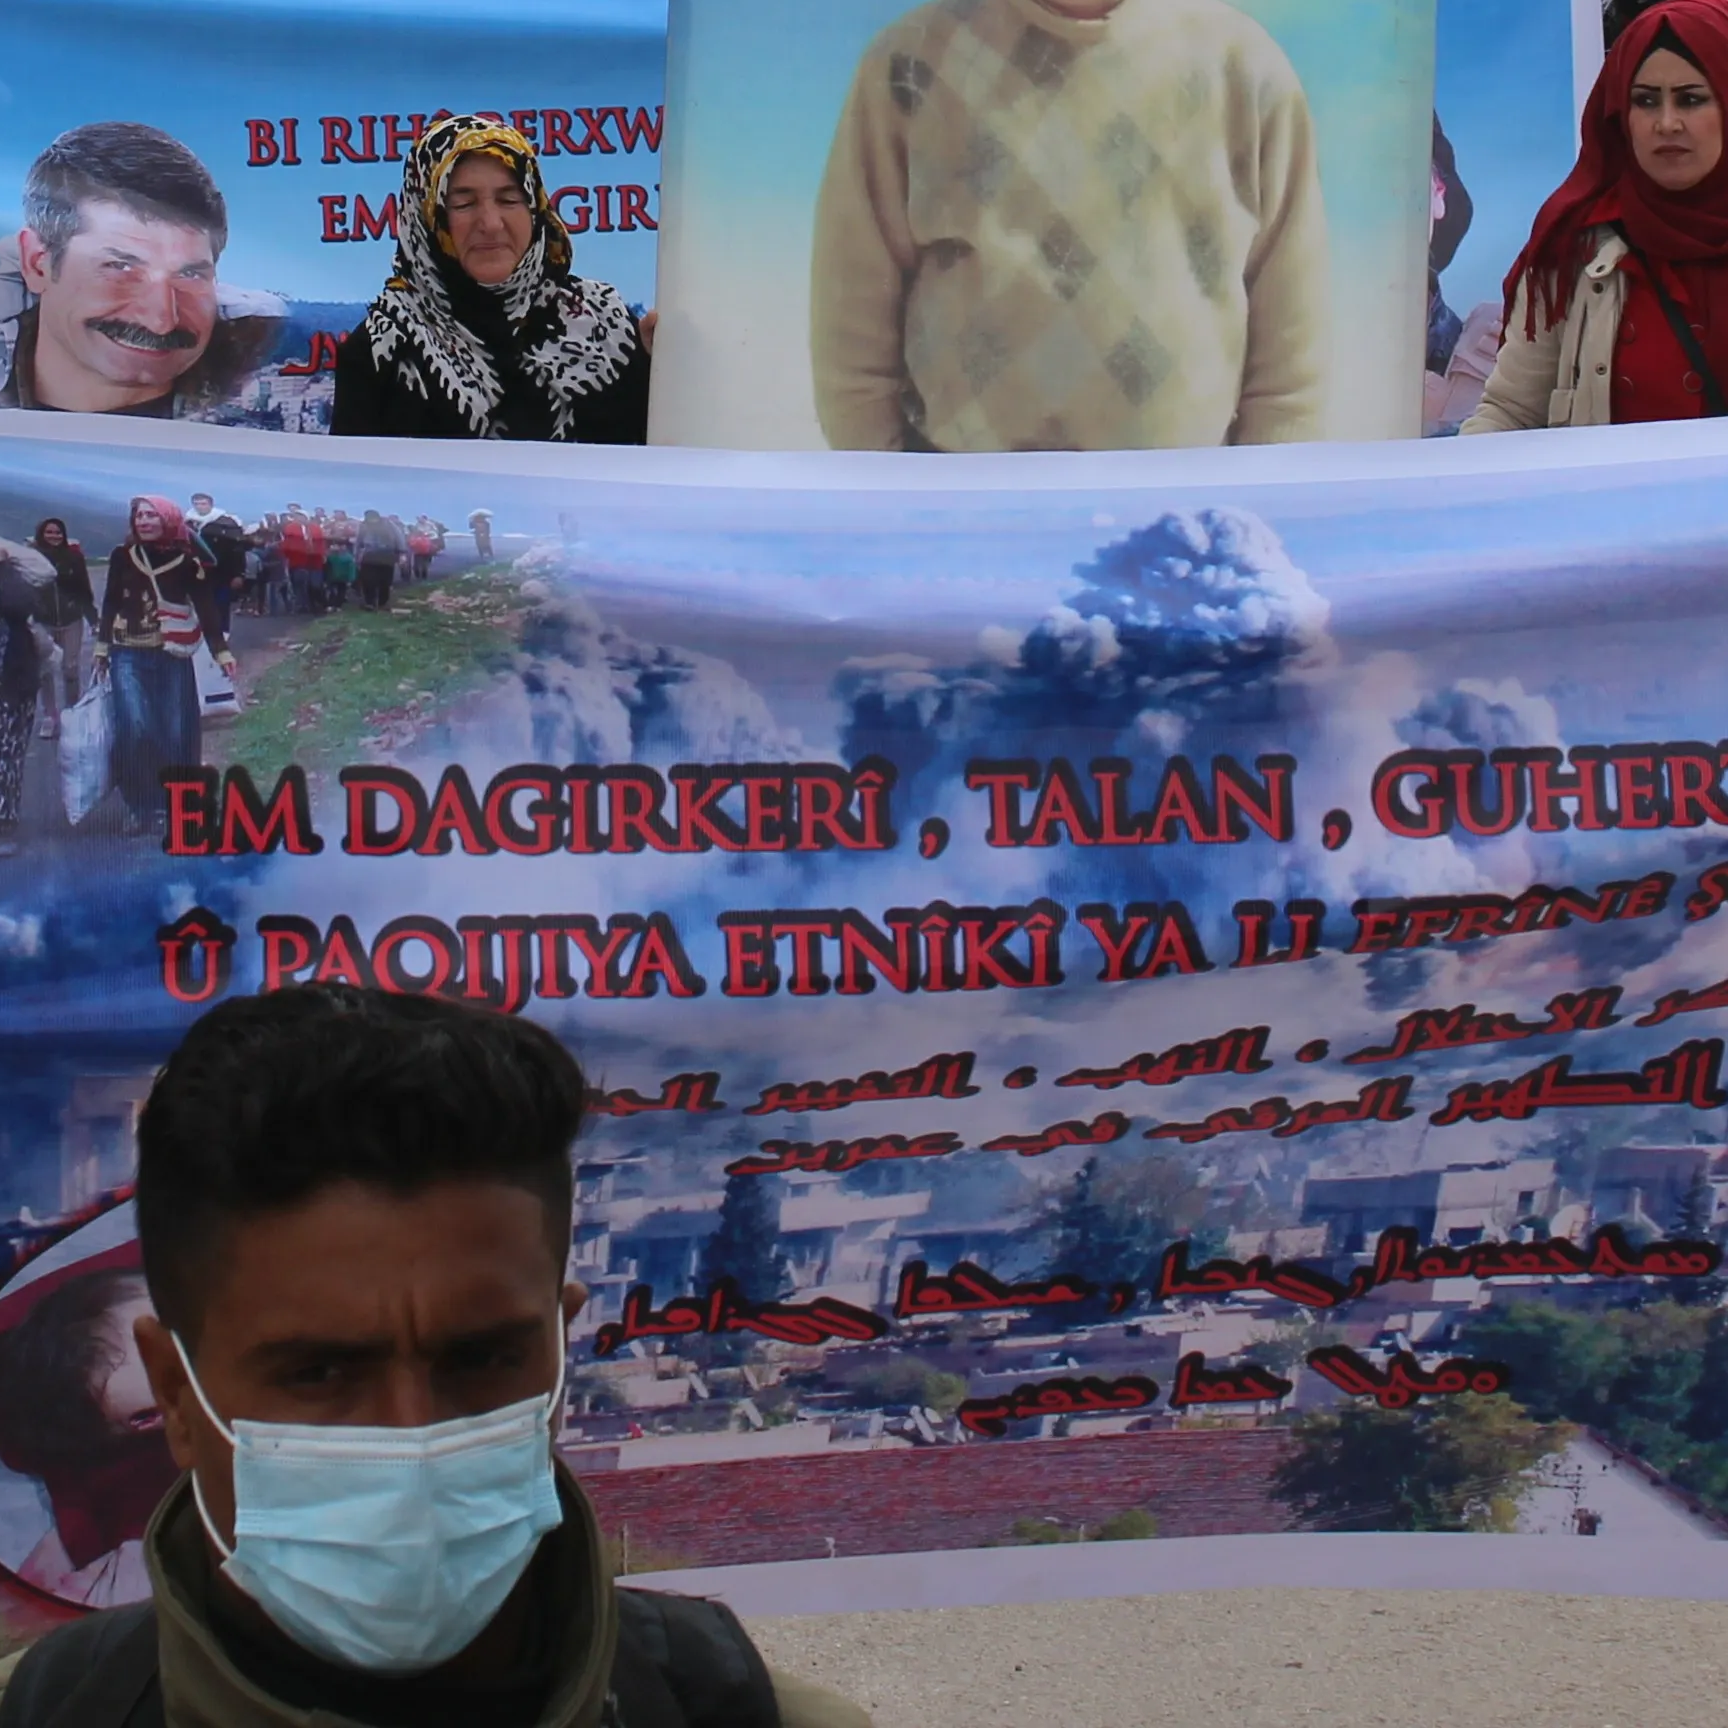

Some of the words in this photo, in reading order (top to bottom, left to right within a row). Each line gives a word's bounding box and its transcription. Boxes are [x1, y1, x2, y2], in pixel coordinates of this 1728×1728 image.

[245, 118, 300, 166] BI
[319, 110, 450, 163] RIH
[159, 769, 322, 855] EM
[339, 756, 897, 855] DAGIRKERÎ
[966, 755, 1295, 847] TALAN
[157, 909, 236, 1002] Û
[258, 914, 706, 1014] PAQIJIYA
[717, 901, 1064, 996] ETNÎKÎ
[1077, 903, 1215, 982] YA
[1228, 900, 1325, 969] LI
[1349, 872, 1675, 956] EFRÎNÊ
[1055, 1025, 1273, 1089] النهب
[1344, 985, 1624, 1065] الاحتلال
[743, 1052, 980, 1114] التغيير
[1142, 1075, 1415, 1143] العرقي
[1429, 1038, 1728, 1124] التطهير
[724, 1131, 965, 1176] عفرين
[981, 1111, 1131, 1156] في
